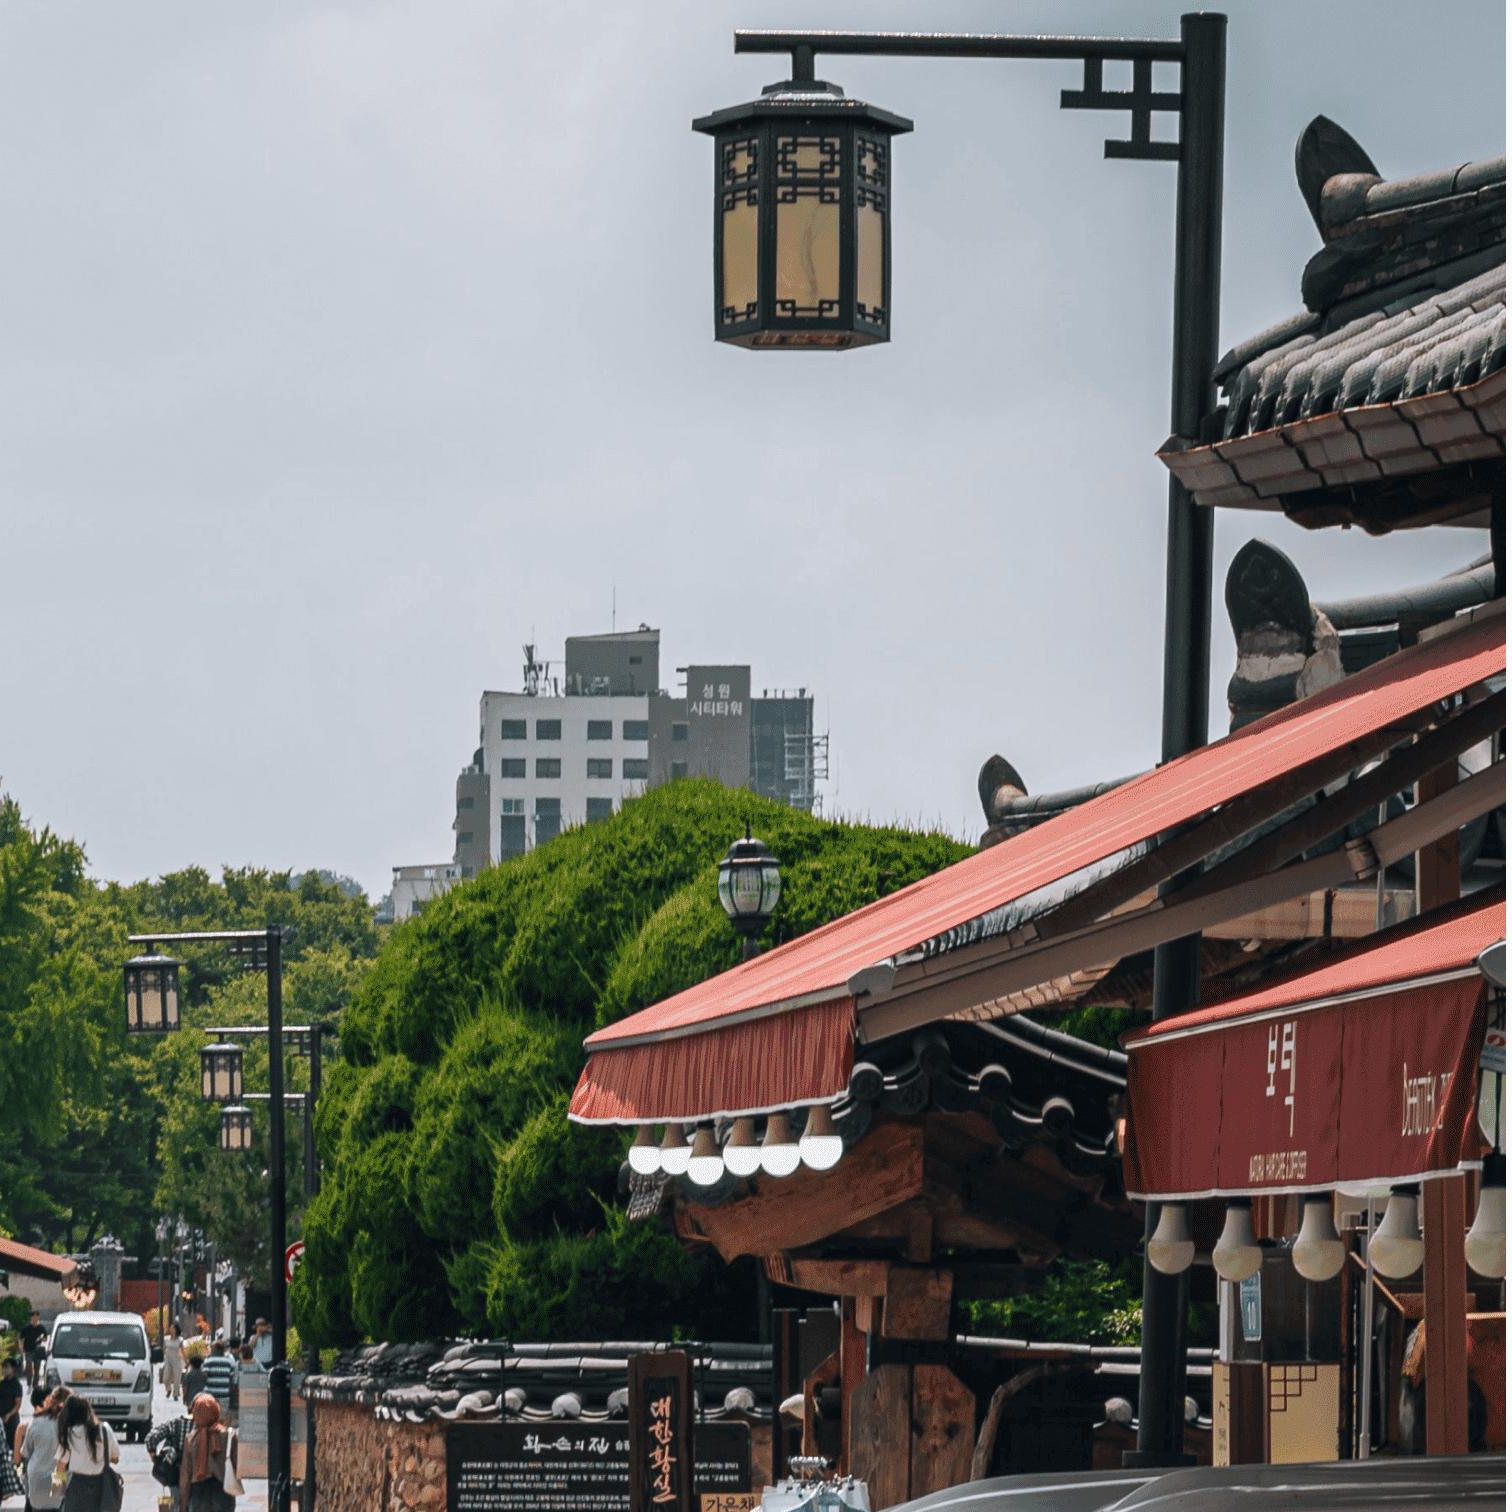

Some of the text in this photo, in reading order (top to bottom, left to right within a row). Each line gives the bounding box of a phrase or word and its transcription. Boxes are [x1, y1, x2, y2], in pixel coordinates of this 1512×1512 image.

[701, 682, 731, 699] 성원
[690, 700, 743, 717] 시티타워
[649, 1395, 677, 1503] 대한황실
